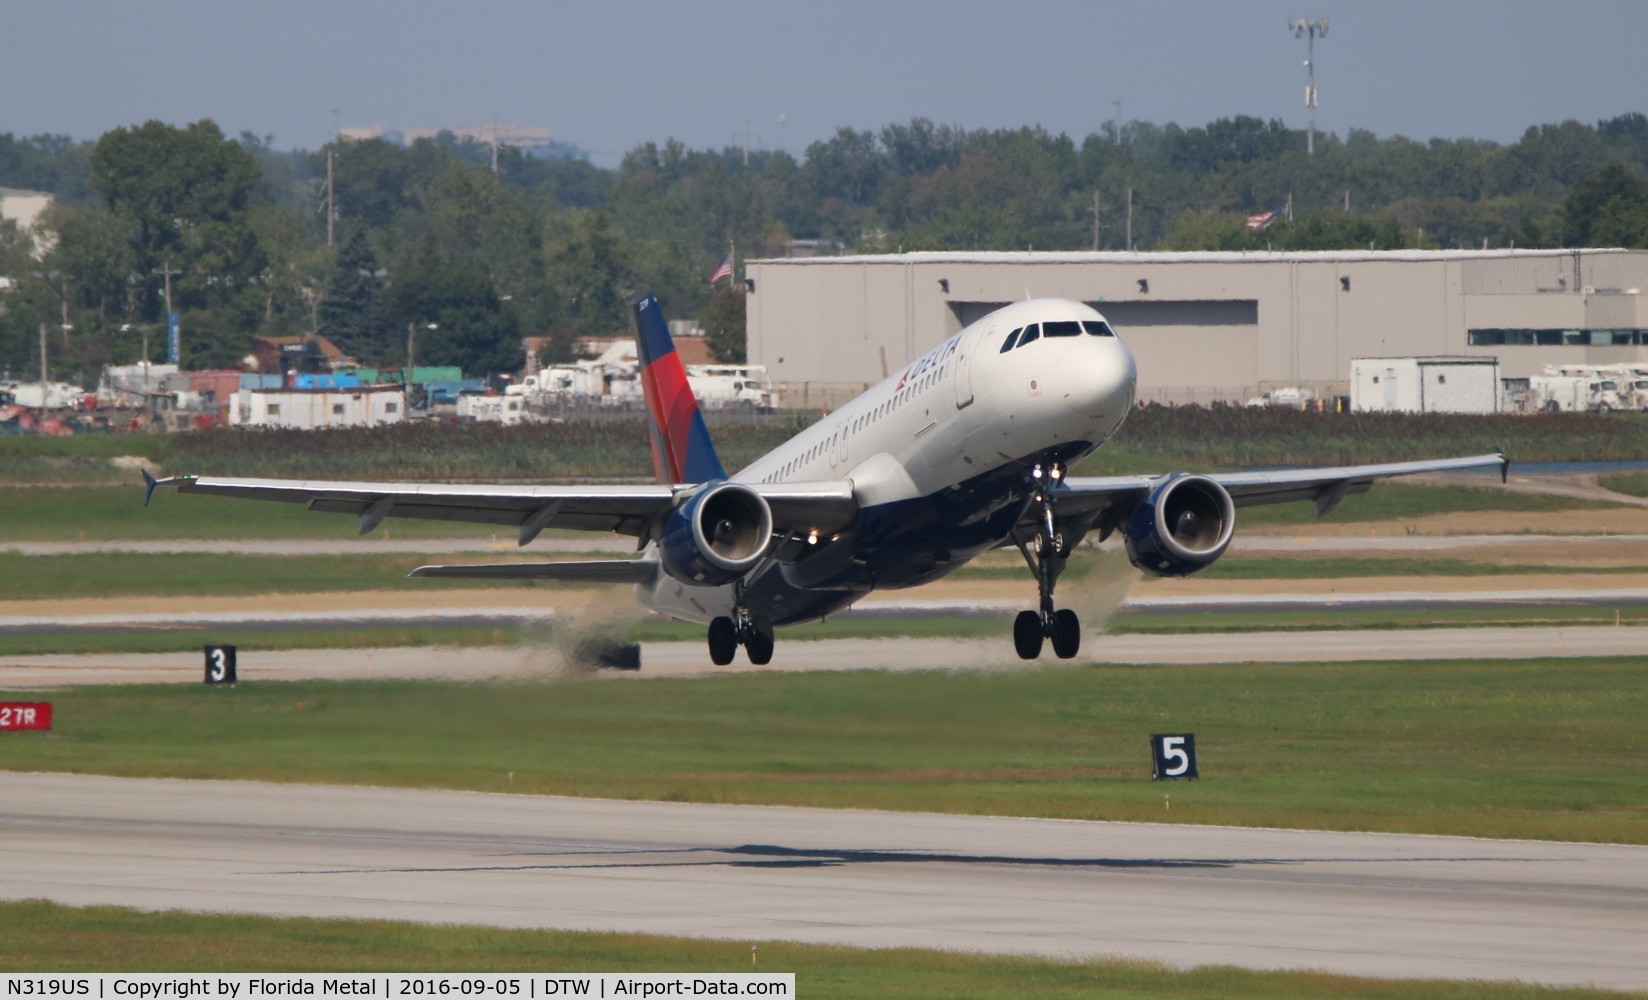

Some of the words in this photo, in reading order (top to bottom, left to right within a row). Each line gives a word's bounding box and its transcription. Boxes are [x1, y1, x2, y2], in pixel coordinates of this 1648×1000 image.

[911, 335, 962, 380] DELTA
[211, 648, 226, 681] 3
[0, 707, 36, 726] 27R
[1162, 736, 1189, 776] 5
